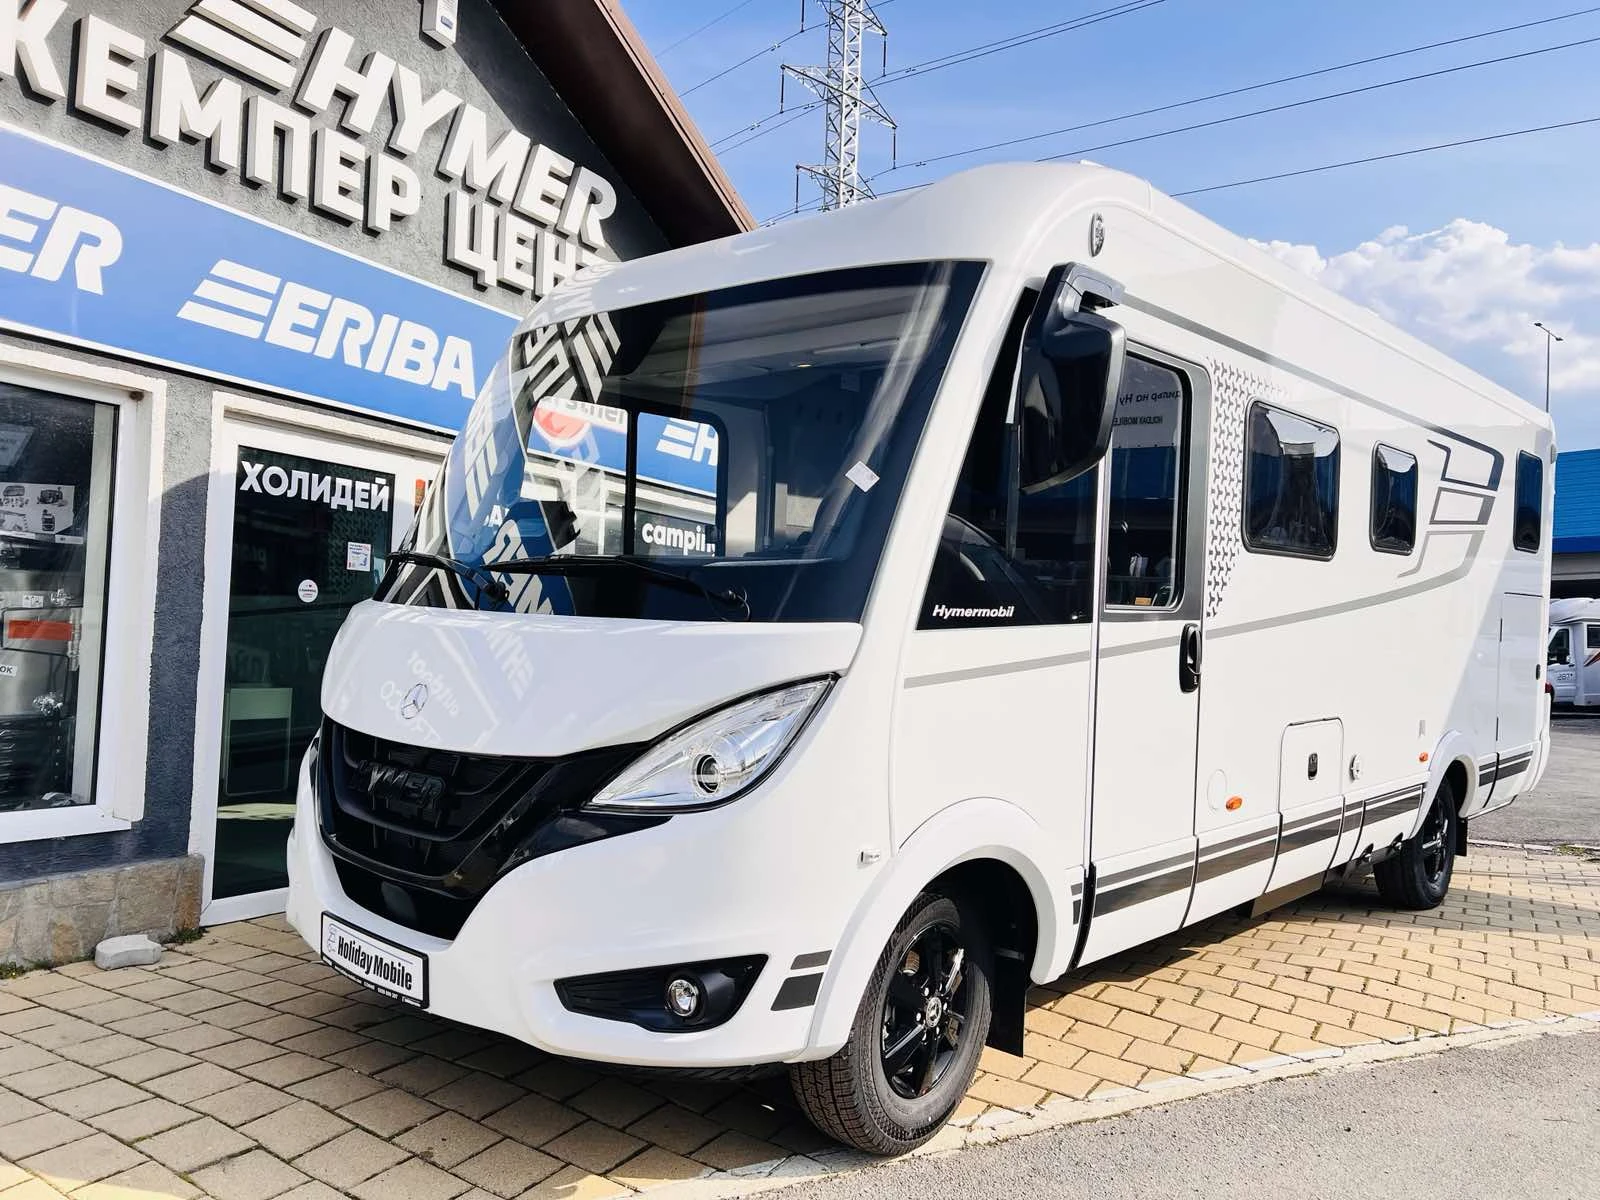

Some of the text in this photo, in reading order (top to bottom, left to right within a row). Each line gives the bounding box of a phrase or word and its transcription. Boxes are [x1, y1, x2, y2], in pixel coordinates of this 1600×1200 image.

[0, 0, 421, 232] КЕМПЕР
[293, 27, 617, 250] HYMER
[264, 283, 477, 400] ERIBA
[240, 460, 390, 512] ХОЛИДЕЙ
[932, 604, 1015, 620] Hymermobil
[337, 935, 373, 976] Holiday
[373, 954, 413, 991] Mobile
